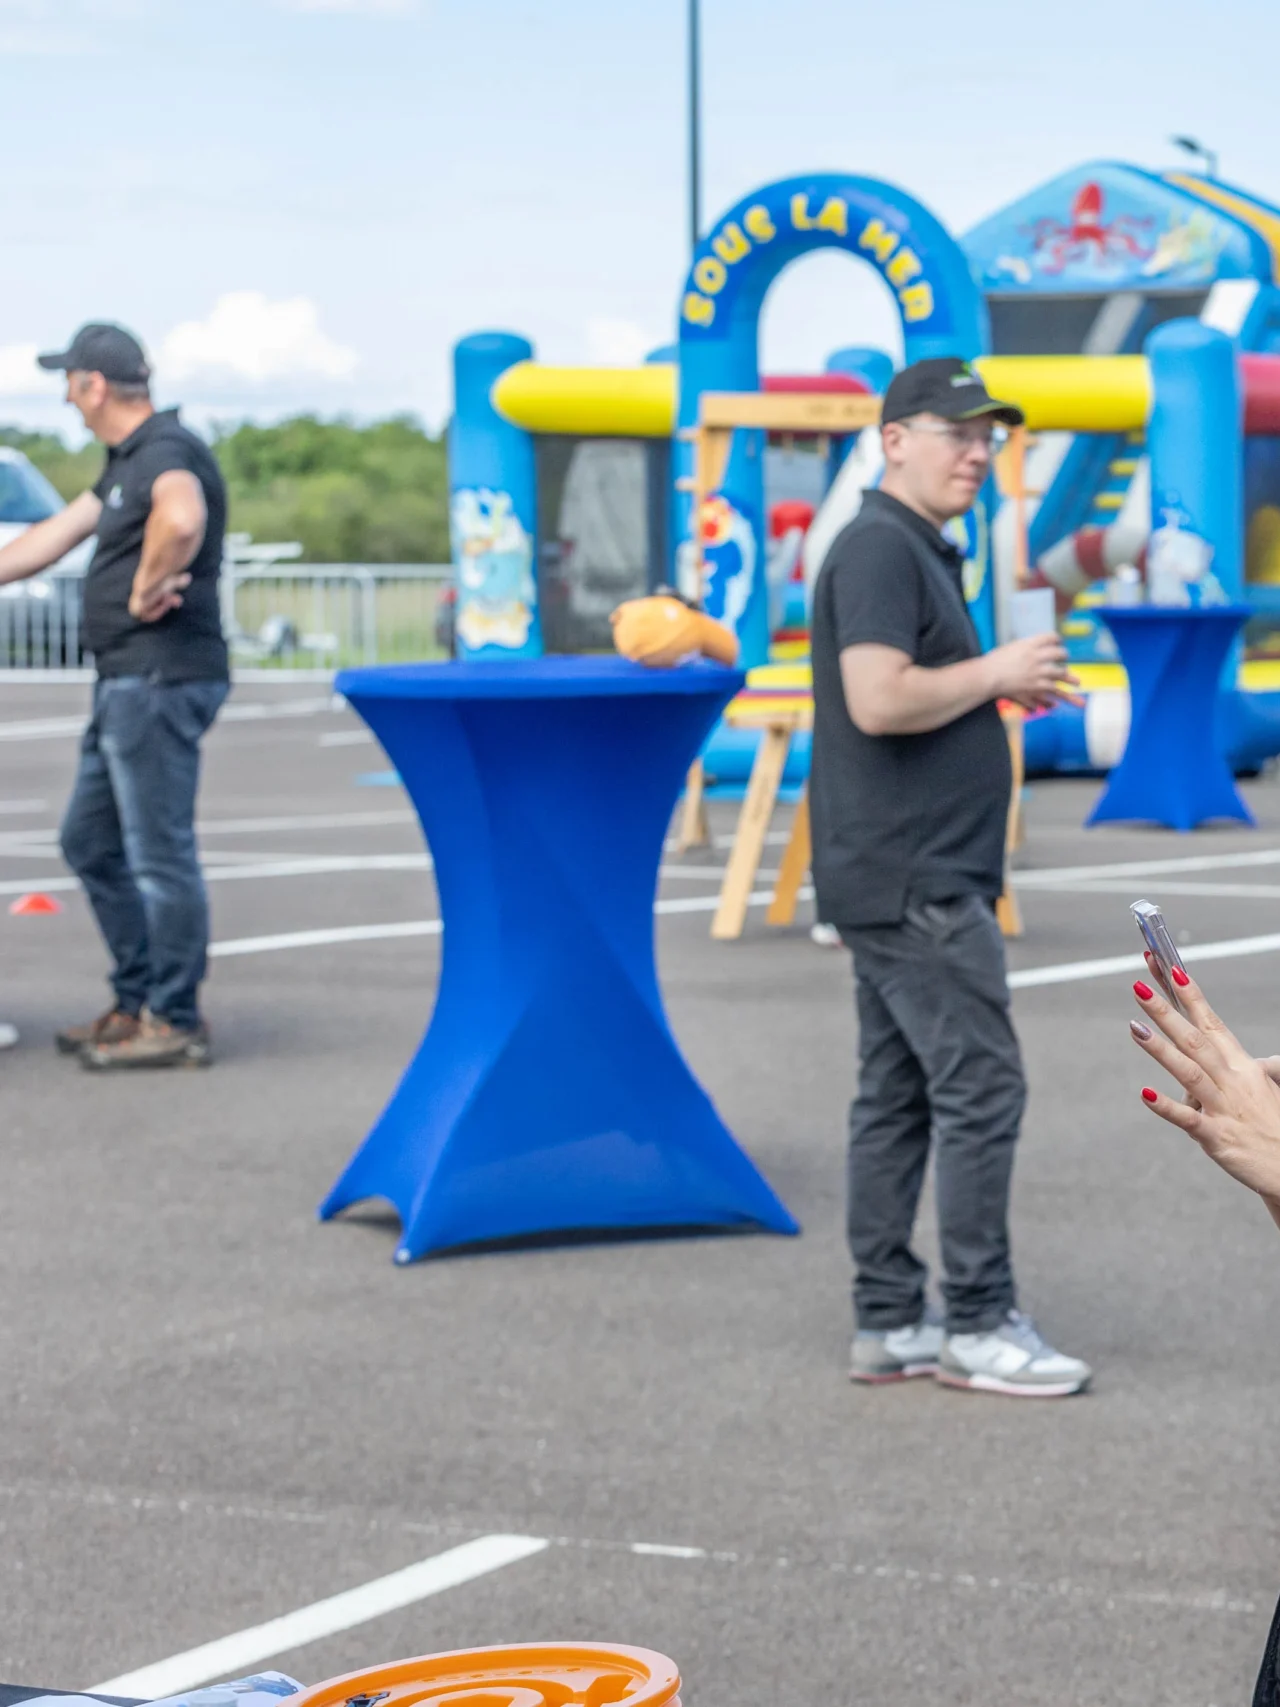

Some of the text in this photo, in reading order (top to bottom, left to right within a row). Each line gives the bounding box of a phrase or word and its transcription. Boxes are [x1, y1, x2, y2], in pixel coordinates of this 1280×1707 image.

[683, 191, 935, 328] SOUS LA MER
